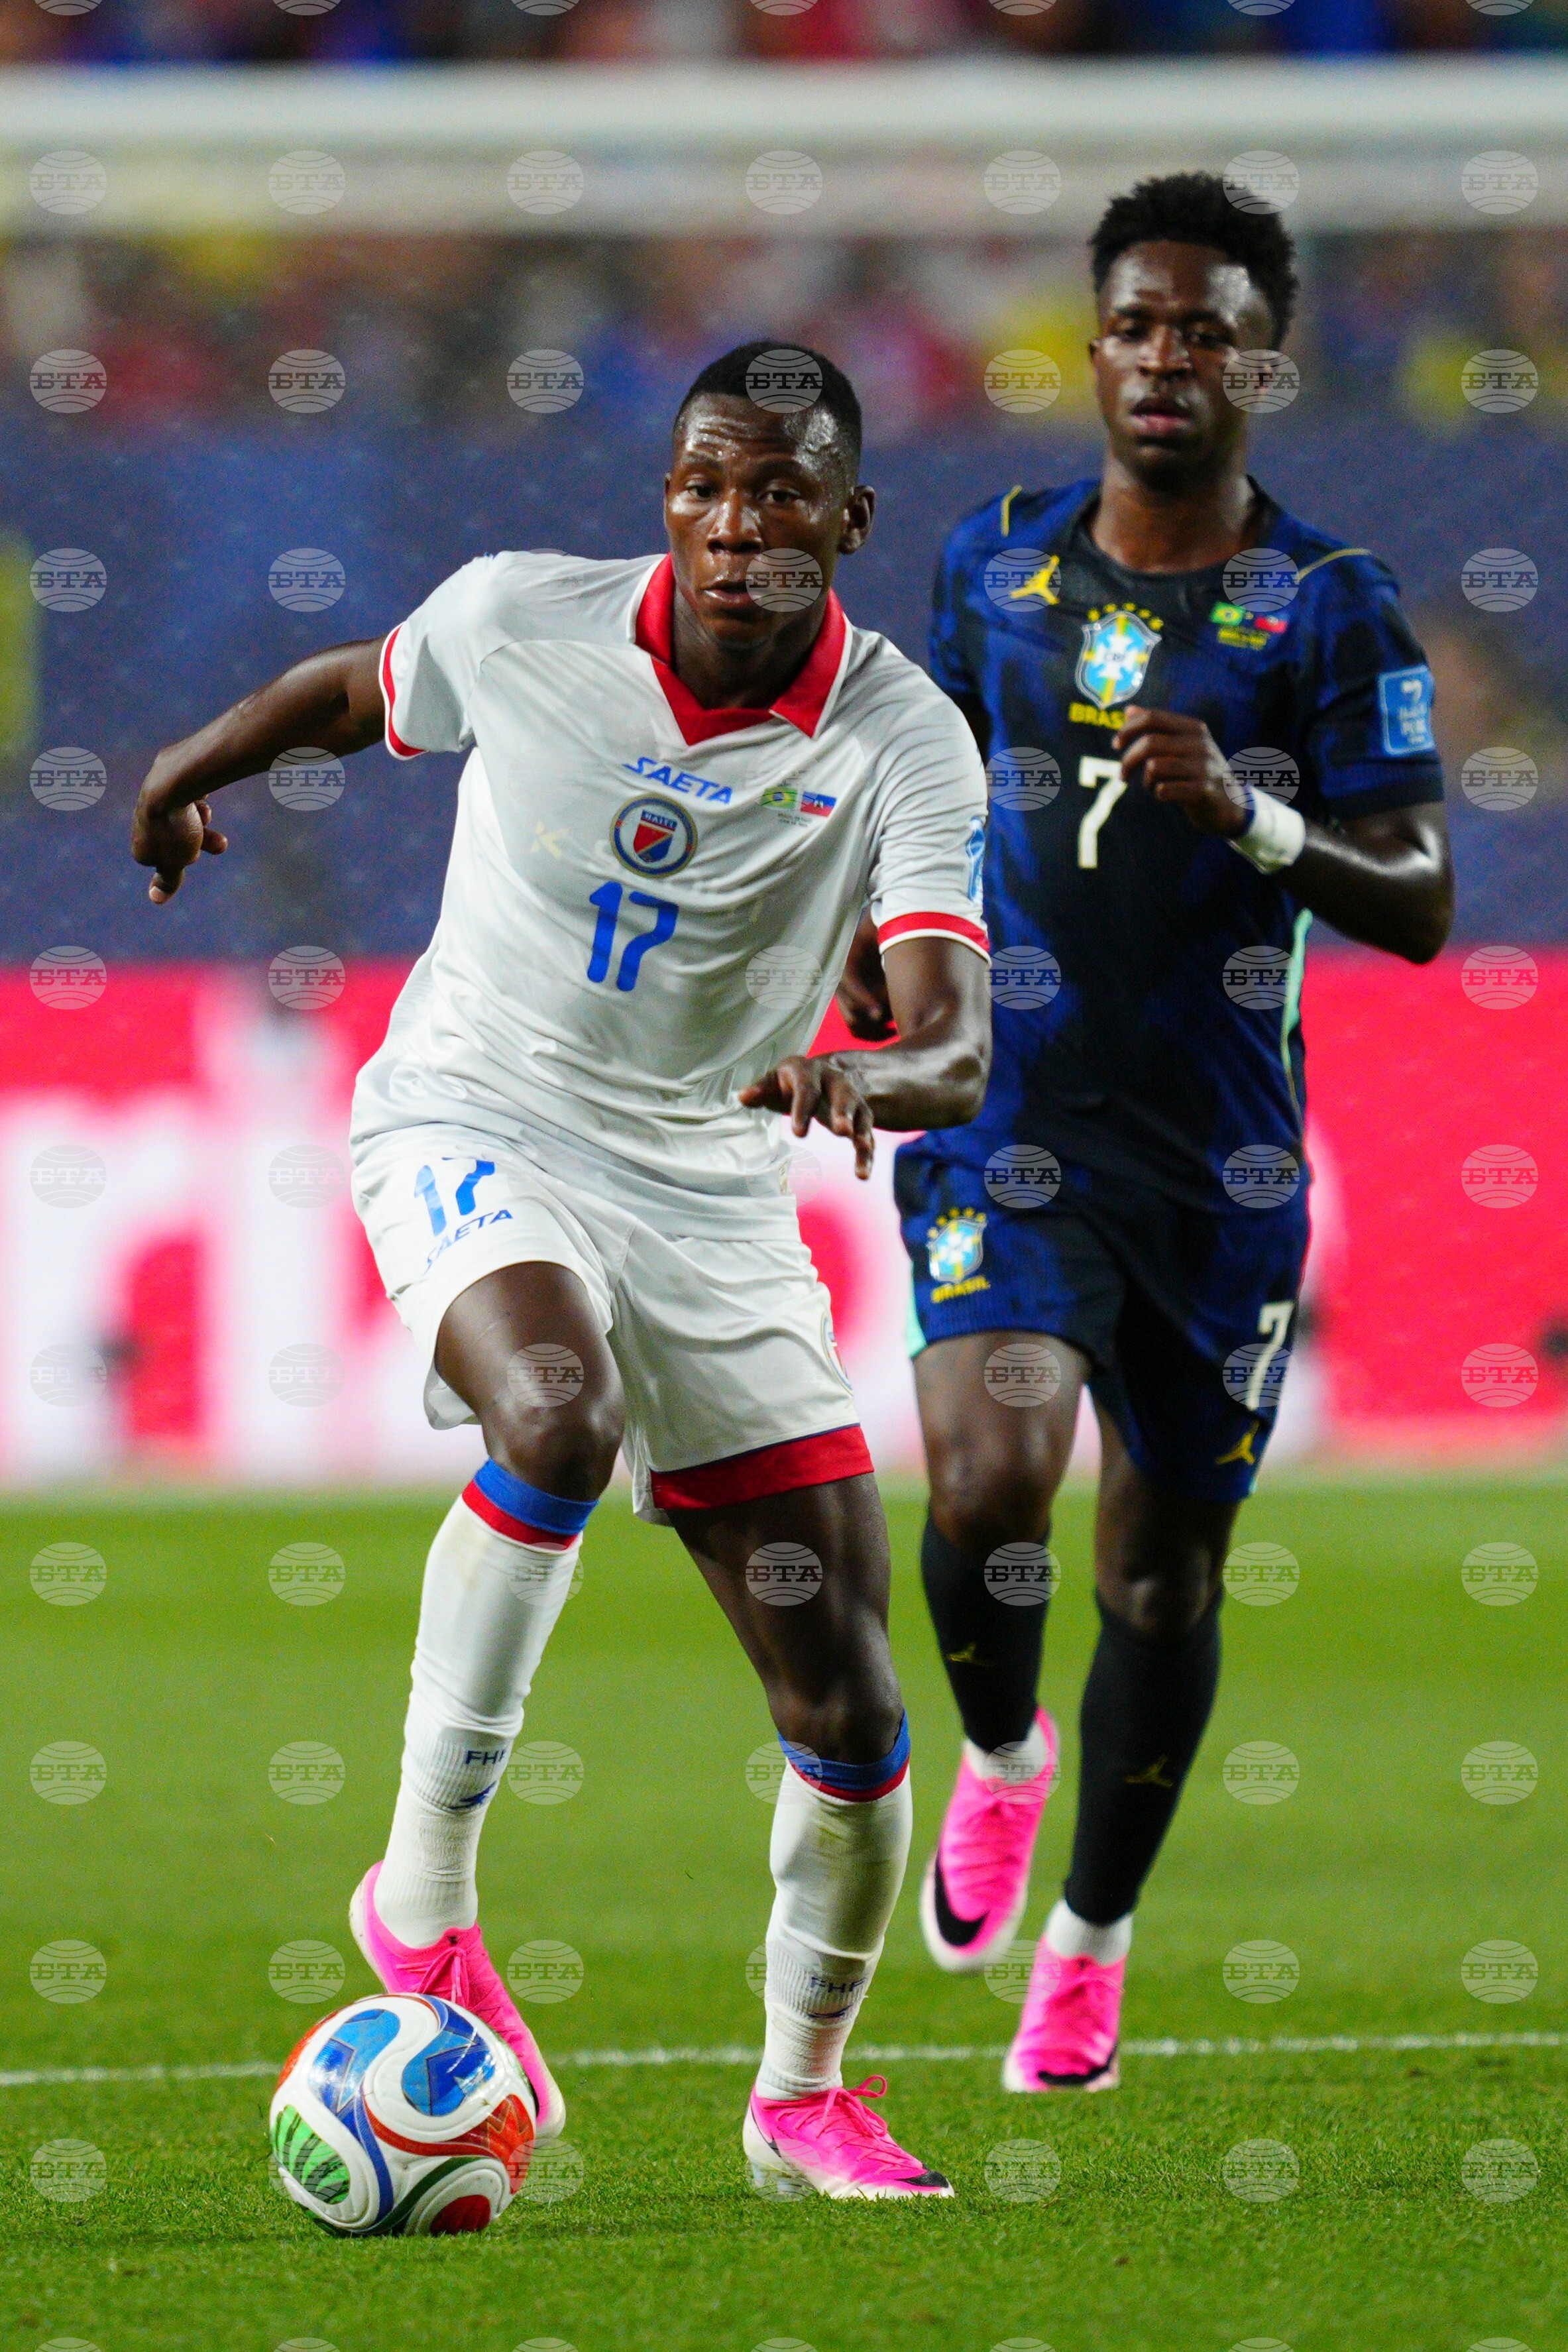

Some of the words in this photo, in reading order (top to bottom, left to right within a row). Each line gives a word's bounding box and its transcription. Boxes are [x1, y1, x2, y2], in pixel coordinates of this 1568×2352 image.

[1069, 701, 1125, 730] BRAS
[622, 756, 733, 805] SAETA
[1078, 755, 1129, 869] 7
[587, 881, 679, 992] 17
[414, 1156, 496, 1237] 17
[423, 1209, 514, 1276] SAETA
[1246, 1301, 1294, 1411] 7
